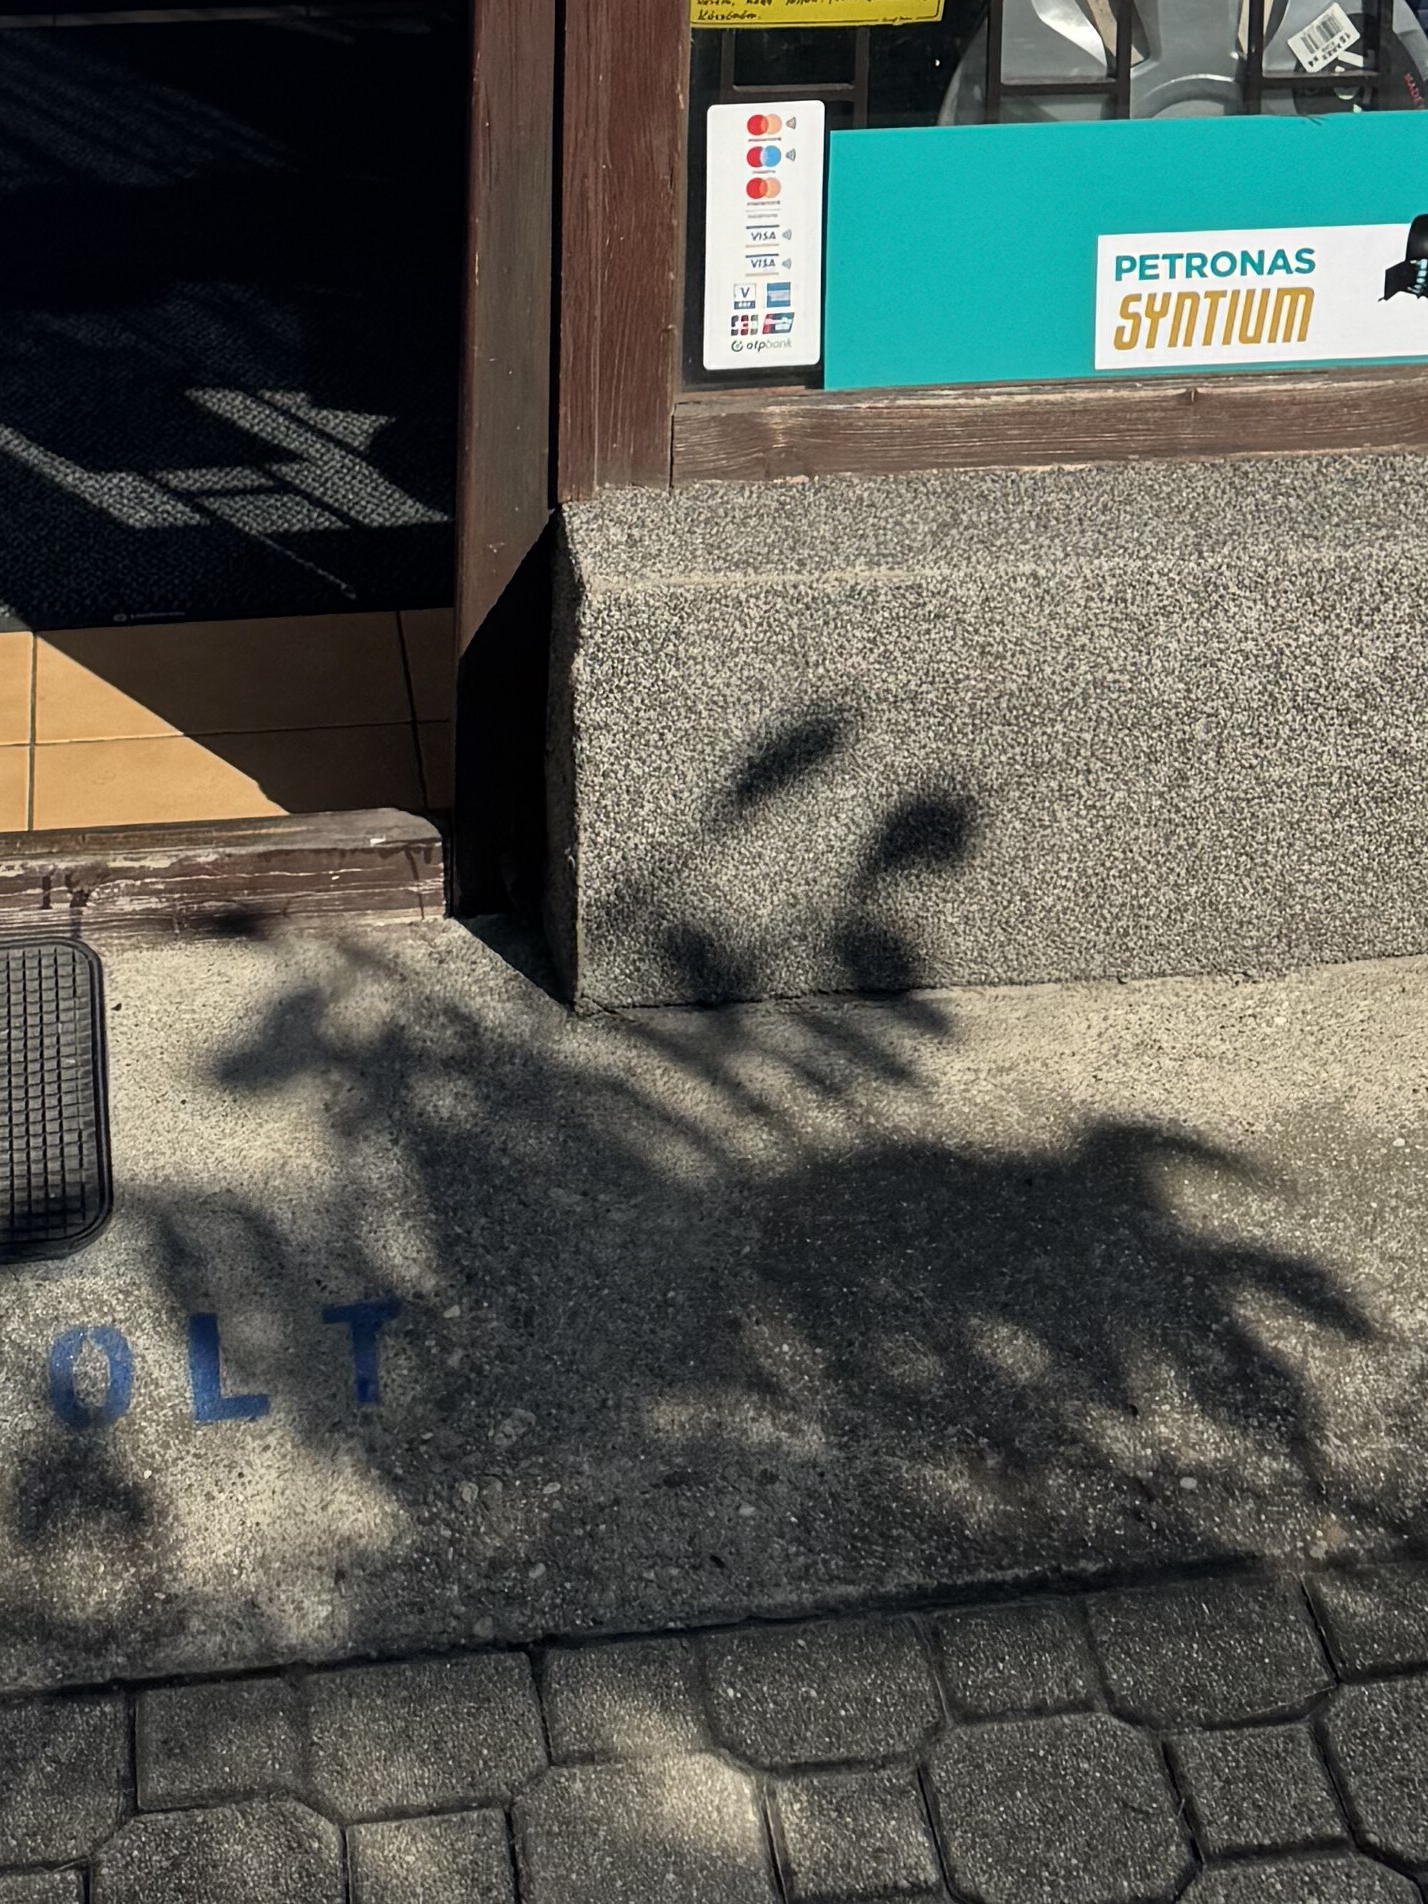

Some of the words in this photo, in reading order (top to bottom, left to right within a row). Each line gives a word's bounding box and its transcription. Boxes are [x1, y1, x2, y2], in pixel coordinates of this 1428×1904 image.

[751, 231, 776, 241] VISA
[750, 258, 776, 268] VISA
[1115, 248, 1316, 281] PETRONAS
[1113, 286, 1315, 350] SYNTIUM
